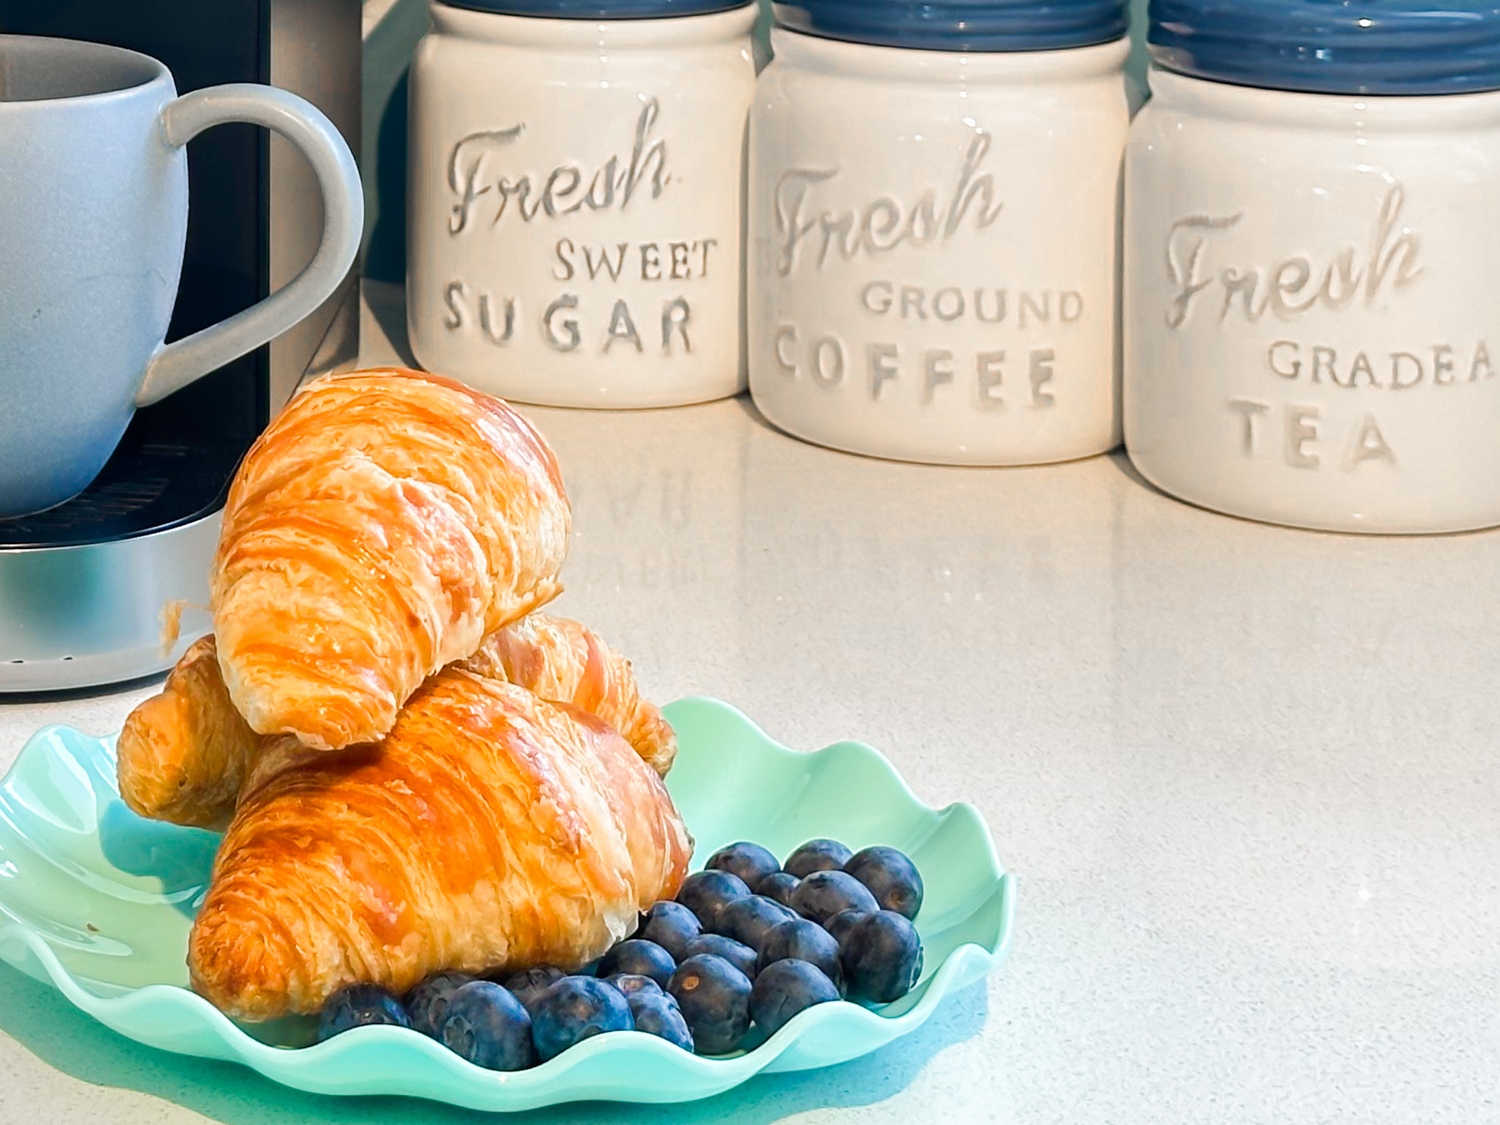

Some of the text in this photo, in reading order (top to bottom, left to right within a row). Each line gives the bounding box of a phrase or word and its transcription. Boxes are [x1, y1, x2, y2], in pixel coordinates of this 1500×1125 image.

[446, 95, 675, 236] Fresh
[774, 130, 1005, 276] Fresh
[550, 237, 719, 283] SWEET
[1163, 182, 1425, 331] Fresh
[442, 280, 698, 358] SUGAR
[859, 278, 1086, 325] GROUND
[772, 323, 1059, 412] COFFEE
[1226, 397, 1399, 472] TEA
